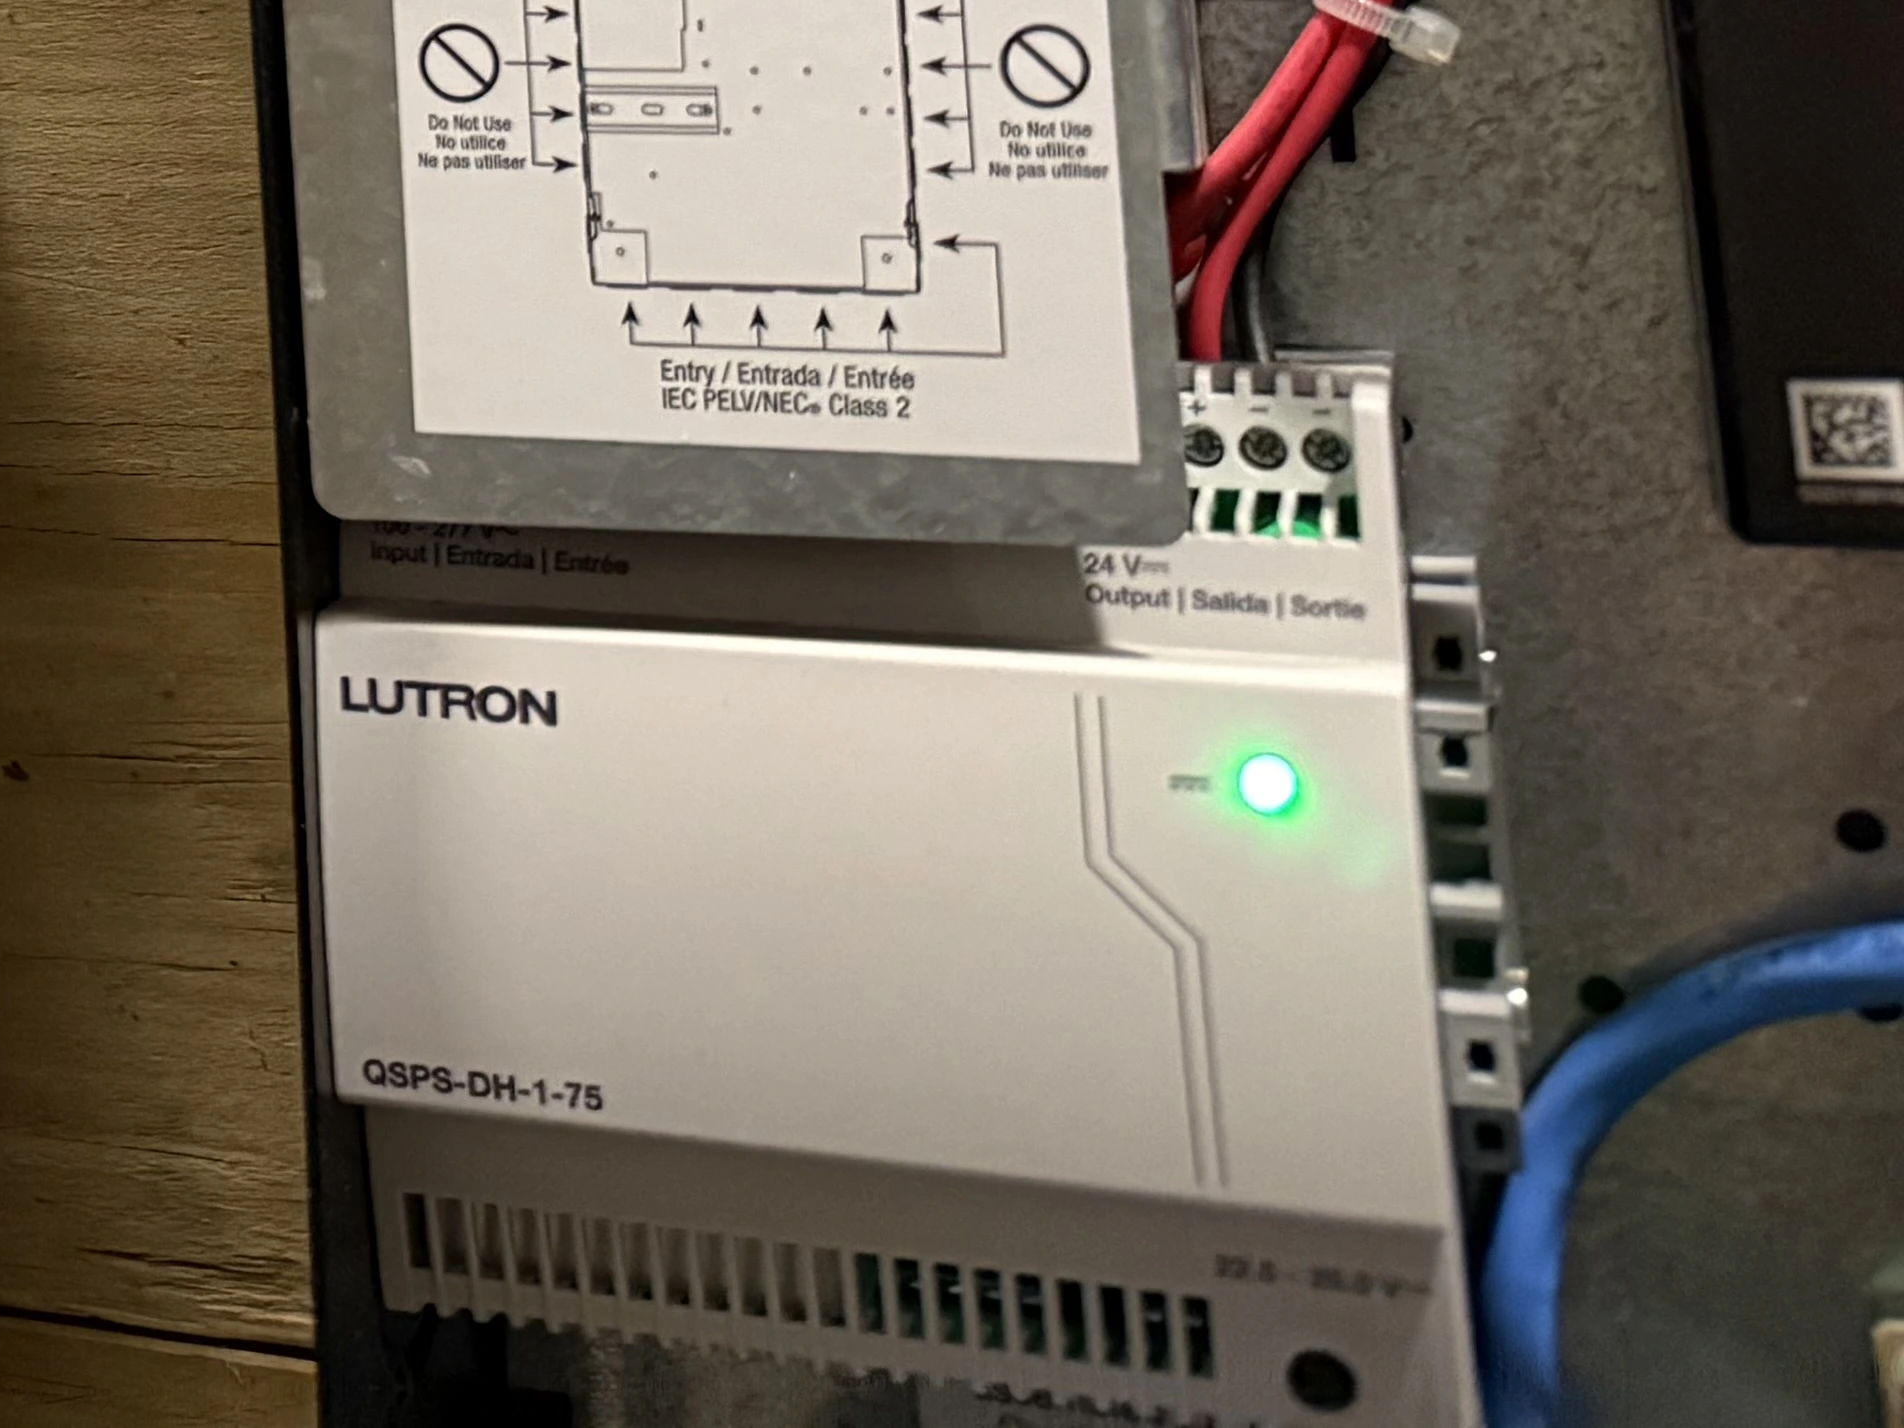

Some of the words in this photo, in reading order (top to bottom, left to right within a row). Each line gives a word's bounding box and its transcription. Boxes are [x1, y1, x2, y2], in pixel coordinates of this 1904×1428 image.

[370, 543, 428, 565] Input
[446, 545, 535, 570] Entrada
[553, 550, 630, 576] Entrée
[1083, 552, 1115, 575] 24
[1085, 583, 1172, 610] Output
[1192, 589, 1269, 615] Salida
[1291, 594, 1367, 621] Sortie
[339, 676, 558, 729] LUTRON
[362, 1057, 605, 1114] QSPS-DH-1-75
